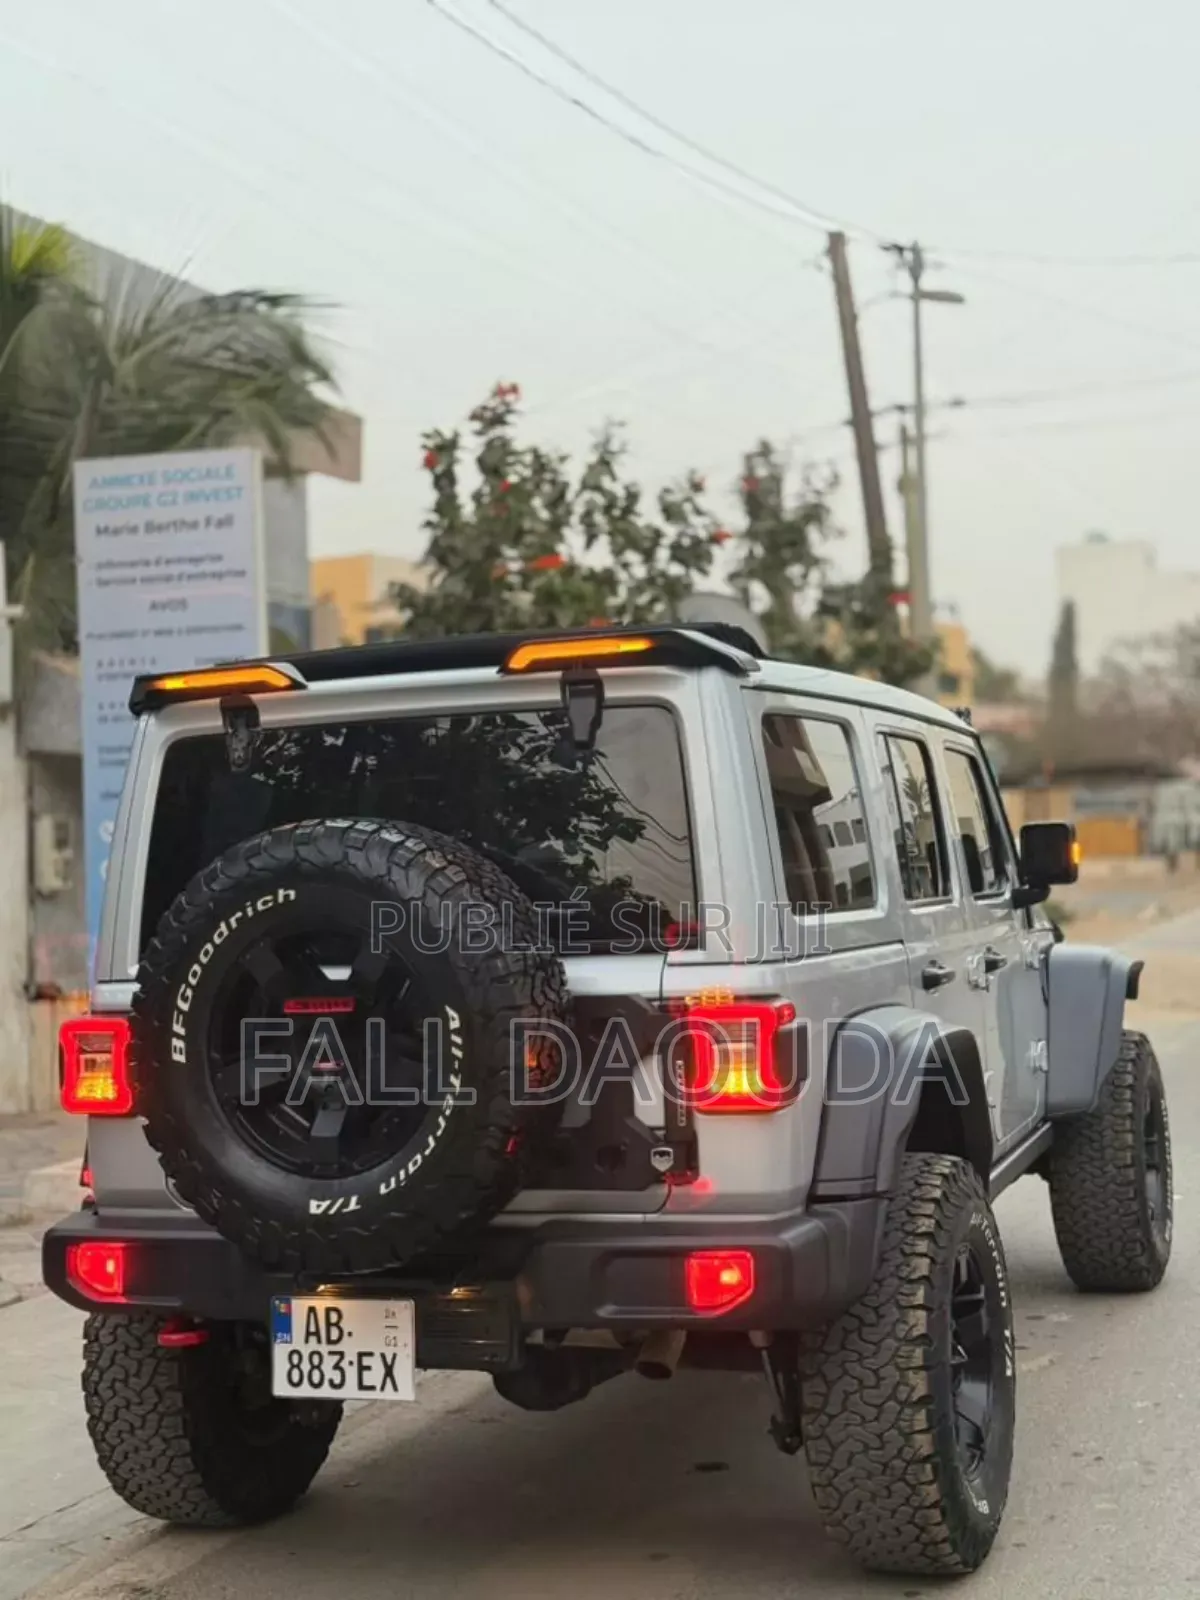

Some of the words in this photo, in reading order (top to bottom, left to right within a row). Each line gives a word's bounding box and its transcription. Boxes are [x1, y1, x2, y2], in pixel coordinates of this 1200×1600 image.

[161, 465, 236, 486] SOCIALE
[95, 520, 140, 539] Marie
[144, 516, 199, 535] Berthe
[204, 513, 235, 531] Fall
[171, 887, 297, 1064] BFGoodrich
[379, 1004, 463, 1195] All-Terrain
[309, 1194, 361, 1215] T/A
